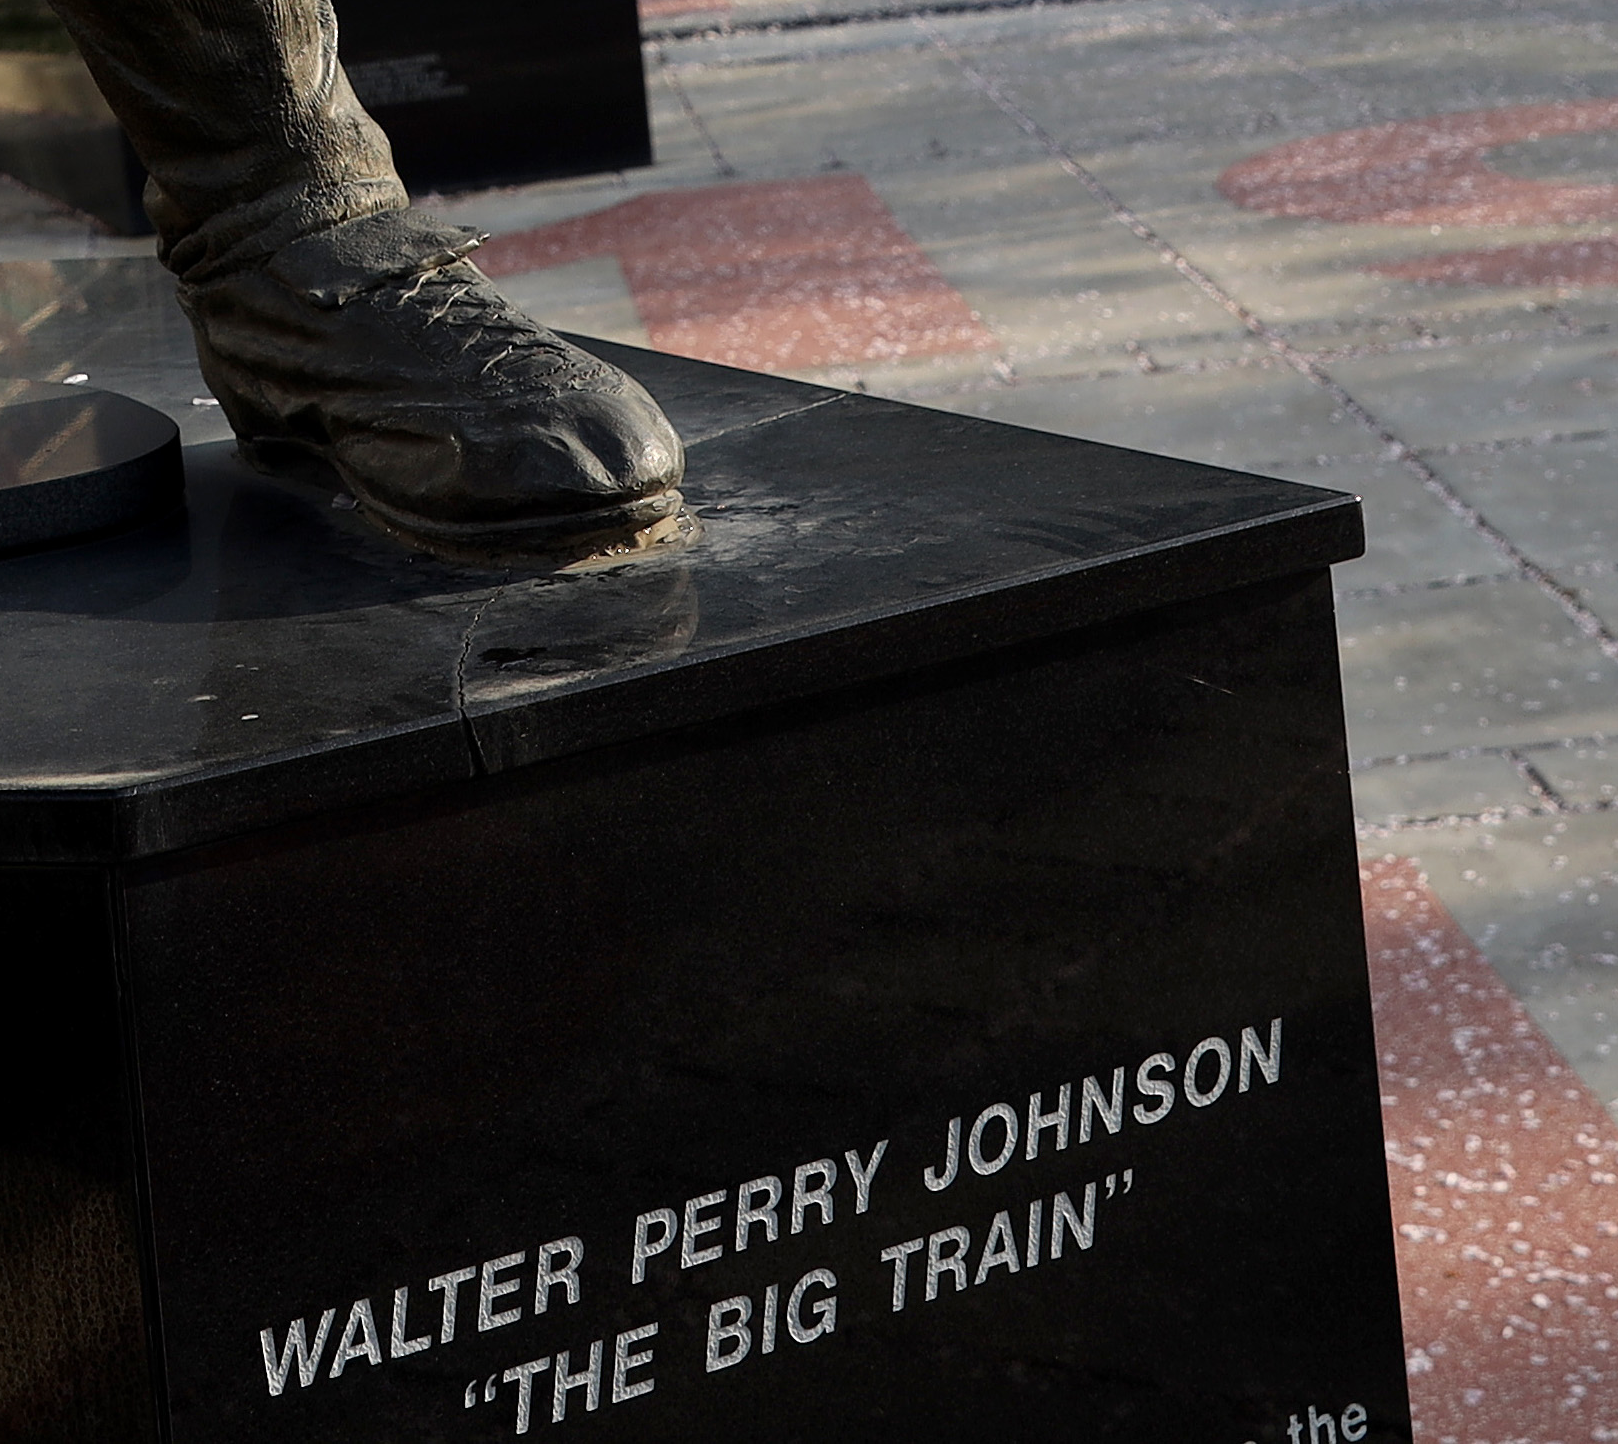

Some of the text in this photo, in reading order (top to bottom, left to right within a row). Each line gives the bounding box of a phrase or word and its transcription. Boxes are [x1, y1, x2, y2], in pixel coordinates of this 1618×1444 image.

[259, 1016, 1283, 1398] WALTER PERRY JOHNSON
[464, 1167, 1134, 1435] “THE BIG TRAIN”
[1286, 1402, 1368, 1444] the
